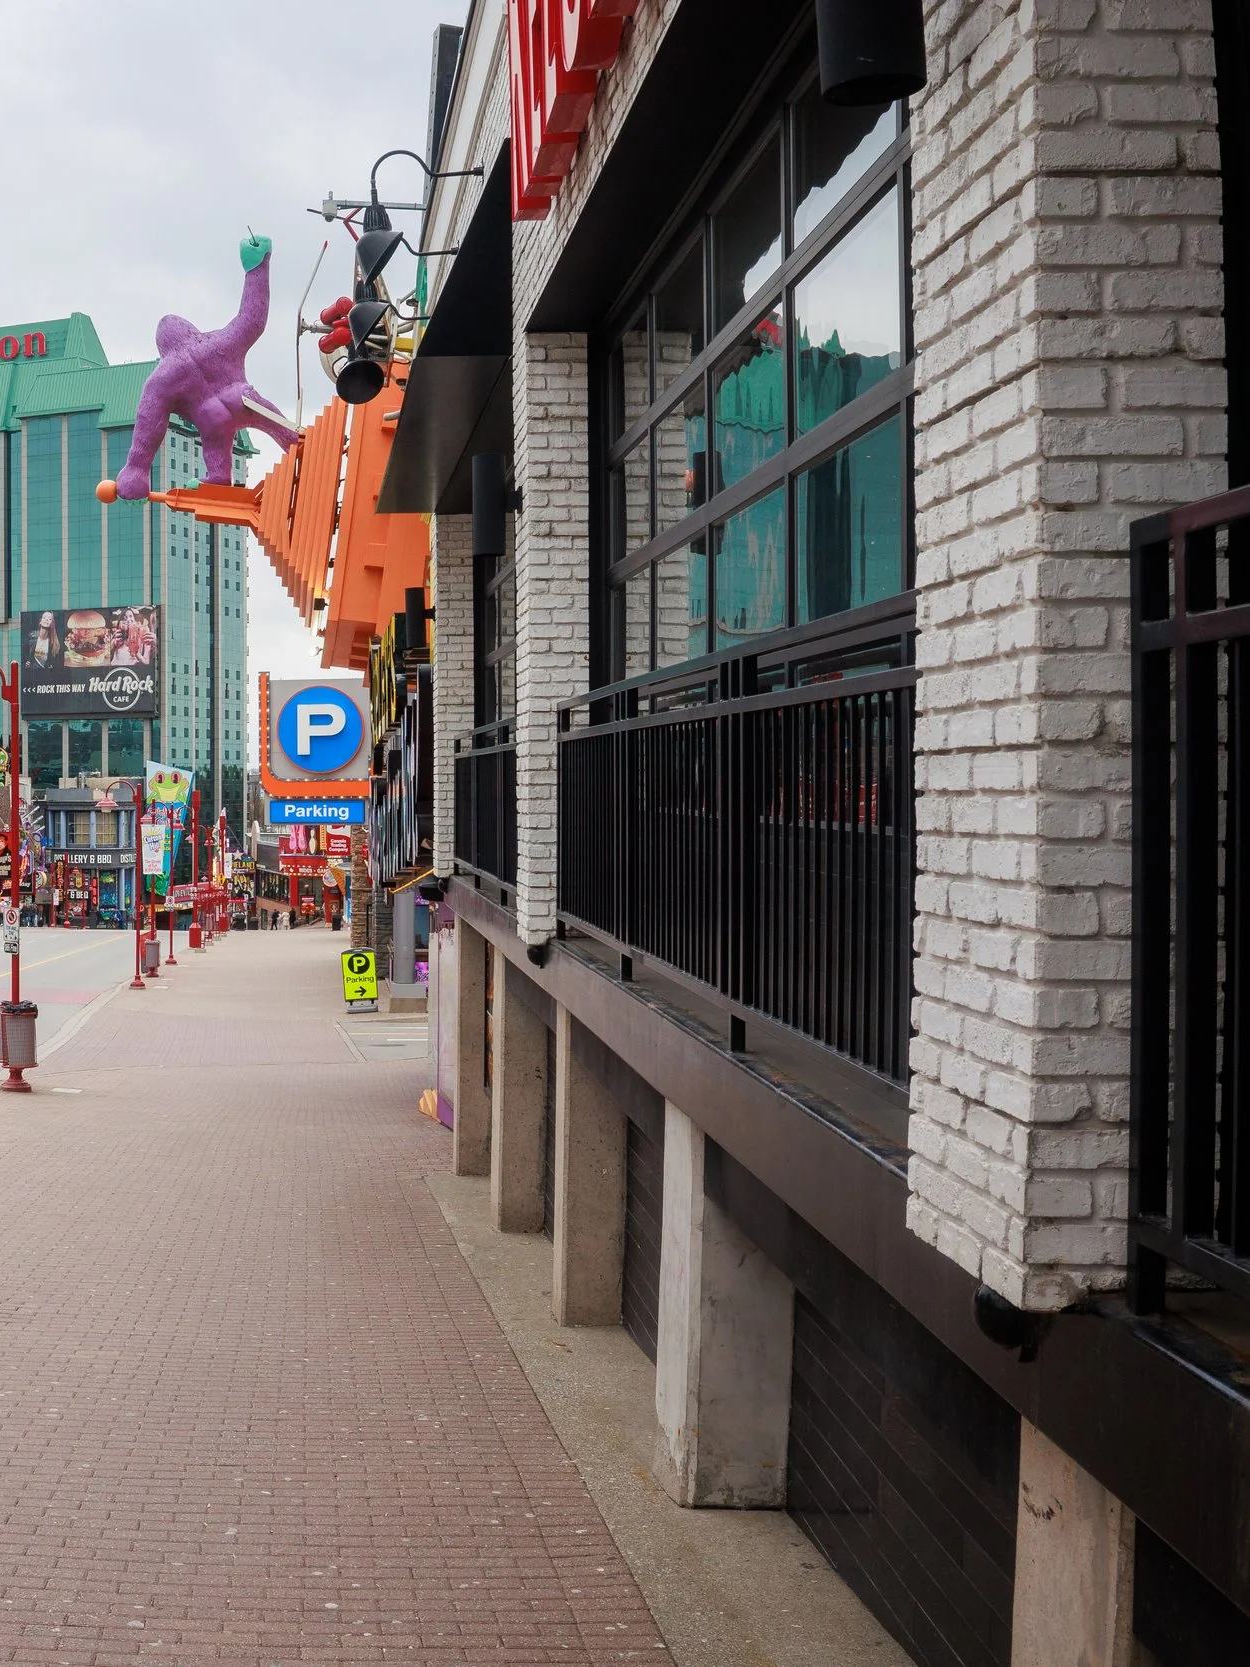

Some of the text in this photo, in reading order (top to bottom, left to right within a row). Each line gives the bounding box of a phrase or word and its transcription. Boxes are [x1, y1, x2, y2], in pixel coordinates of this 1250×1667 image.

[37, 684, 86, 694] ROCK THIS WAY
[89, 675, 153, 694] Hard Rock
[297, 704, 346, 756] P
[285, 805, 350, 820] Parking
[54, 854, 112, 864] DISTLLERY & BBQ
[353, 956, 366, 972] P
[347, 975, 375, 986] Parking
